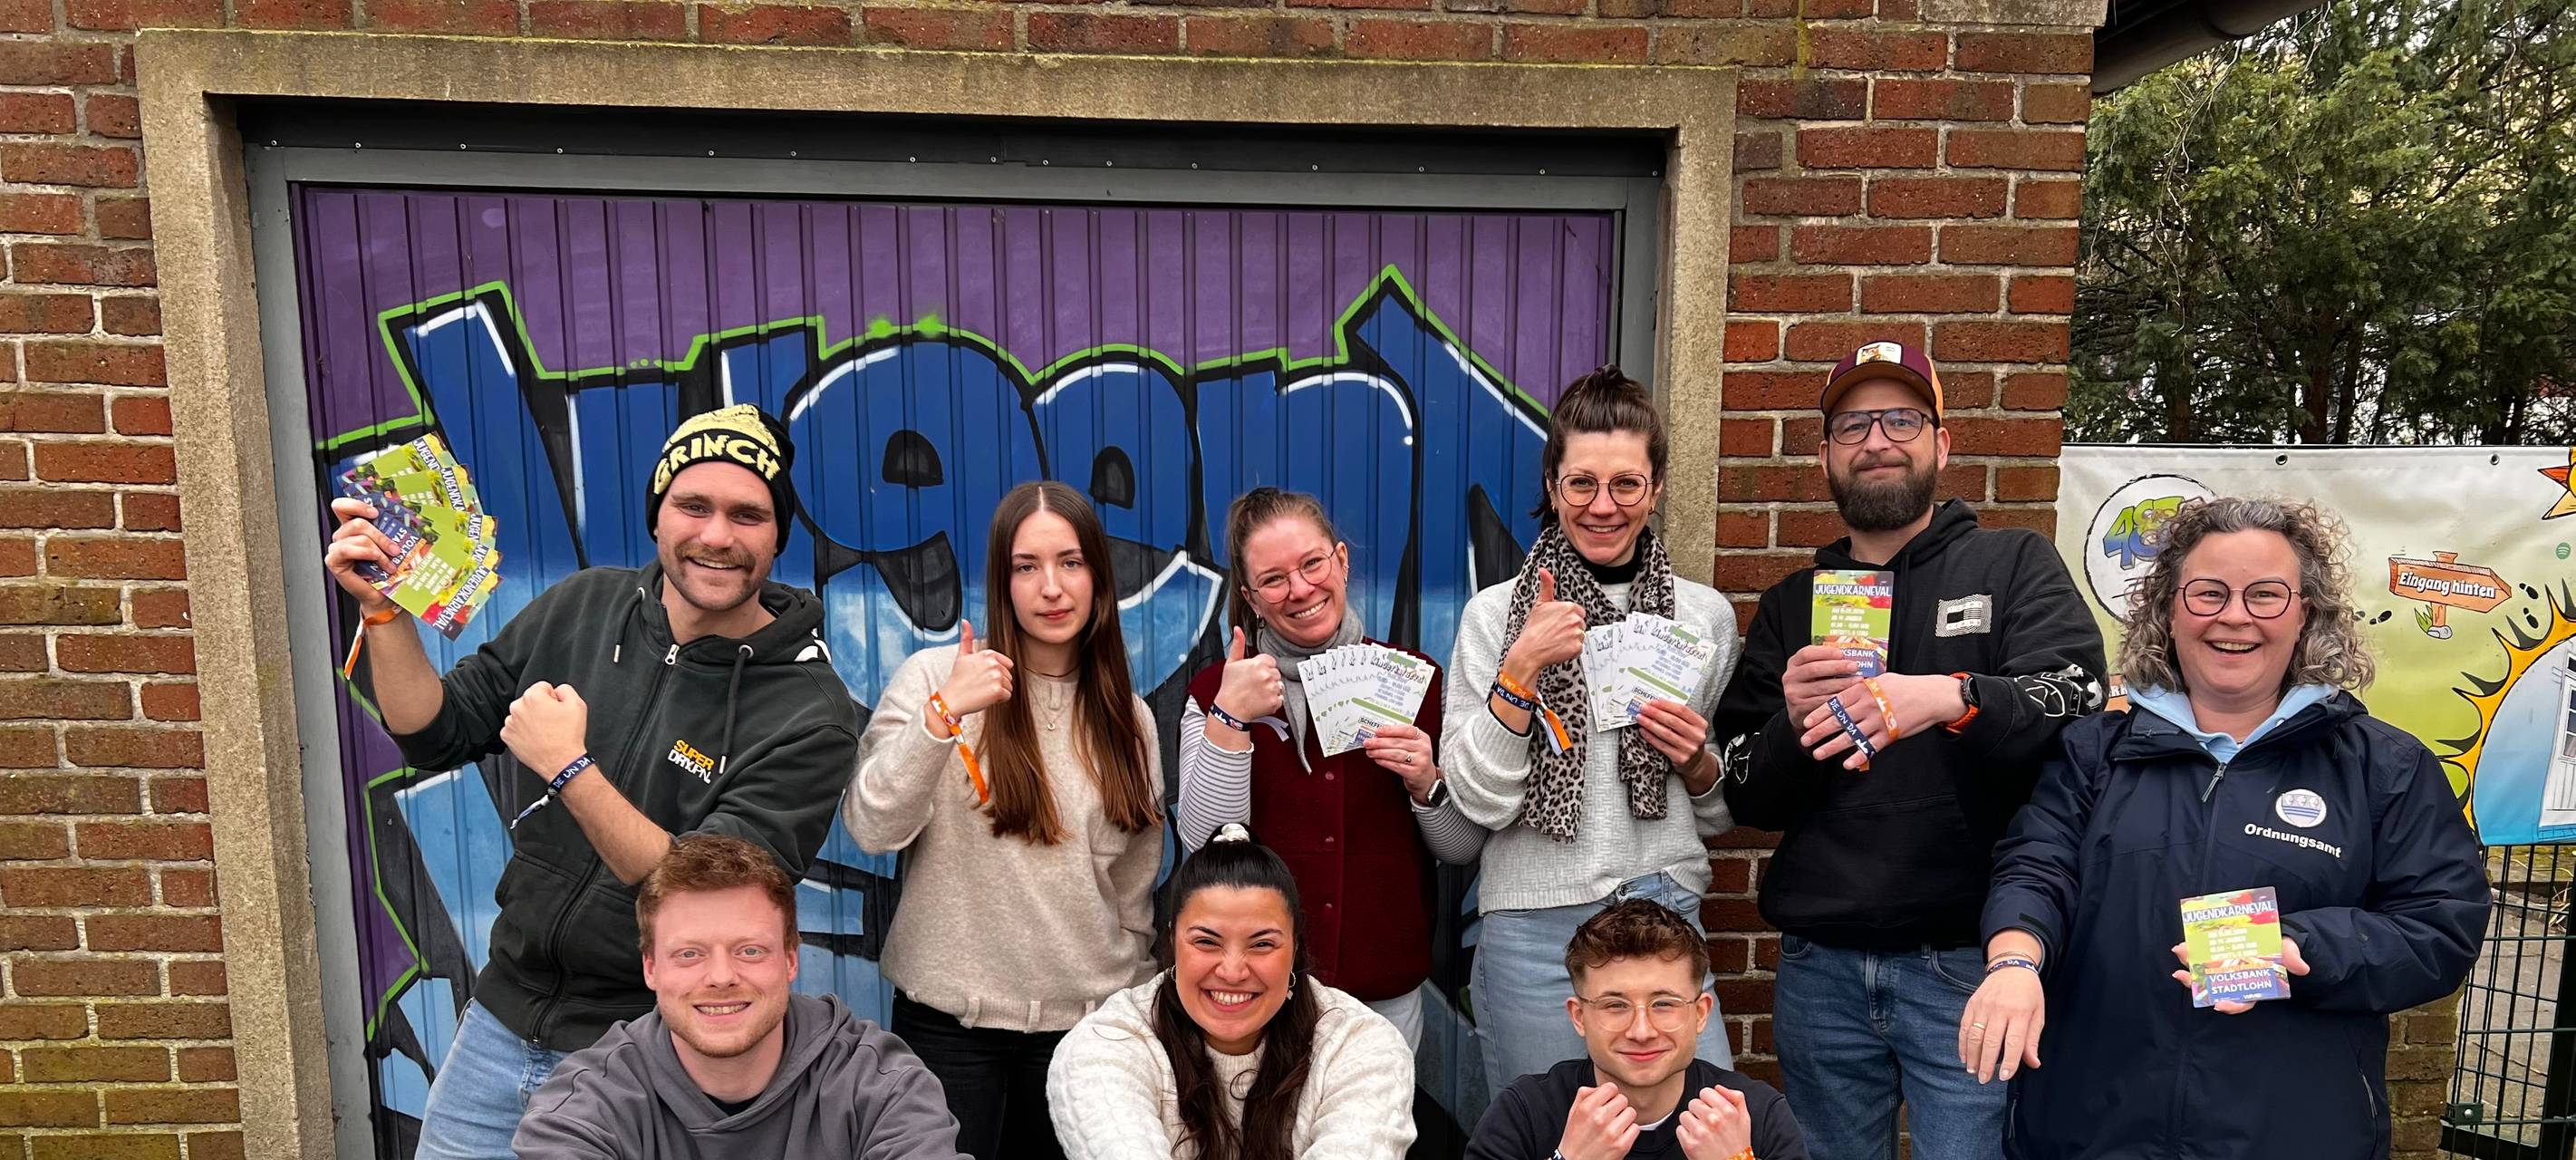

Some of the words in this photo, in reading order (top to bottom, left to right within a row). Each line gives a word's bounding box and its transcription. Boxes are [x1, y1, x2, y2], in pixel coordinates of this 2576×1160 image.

[653, 432, 781, 495] GRINCH
[431, 565, 491, 630] JUGENDKARNEVAL
[1815, 585, 1891, 596] JUGENDKARNEVAL
[2398, 572, 2452, 595] Eingang
[2452, 580, 2495, 598] hinten
[1830, 699, 1839, 710] DE
[1838, 710, 1848, 724] UN
[1847, 723, 1857, 735] DA
[673, 740, 715, 769] SUPER
[2244, 823, 2341, 858] Ordnungsamt
[2184, 901, 2276, 923] JUGENDKARNEVAL
[2209, 969, 2271, 982] VOLKSBANK
[2211, 981, 2272, 994] STADTLOHN
